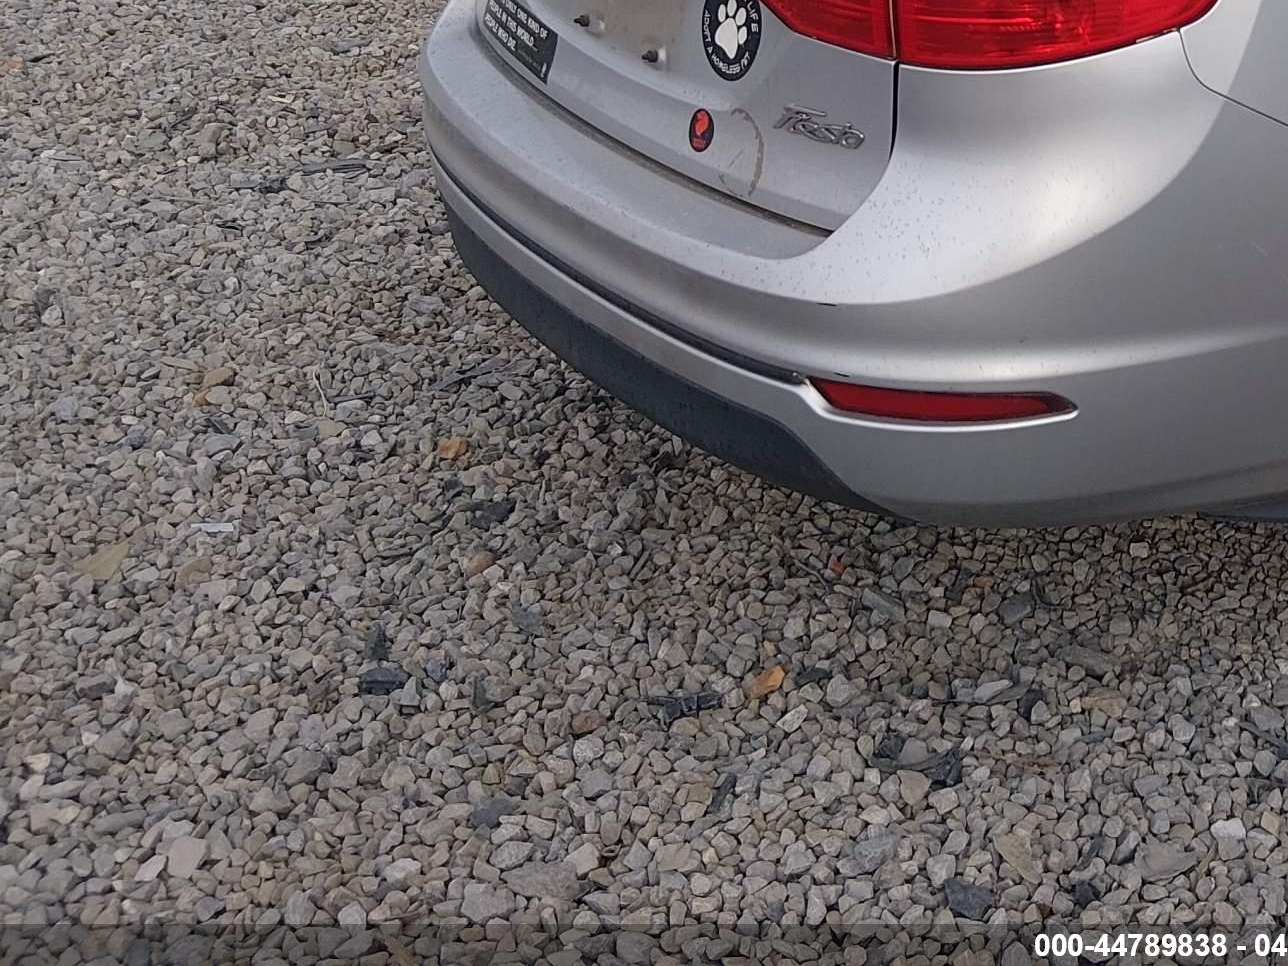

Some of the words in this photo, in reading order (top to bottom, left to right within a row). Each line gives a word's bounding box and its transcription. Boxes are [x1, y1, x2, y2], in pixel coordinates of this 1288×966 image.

[484, 13, 500, 33] PEOPLE
[497, 26, 509, 43] WHO
[506, 16, 518, 33] THIS
[517, 8, 528, 25] ONE
[527, 17, 541, 34] KIND
[540, 27, 549, 40] OF
[703, 9, 712, 43] ADOPT
[747, 0, 759, 33] LIFE
[707, 45, 714, 54] A
[711, 53, 741, 74] HOMELESS
